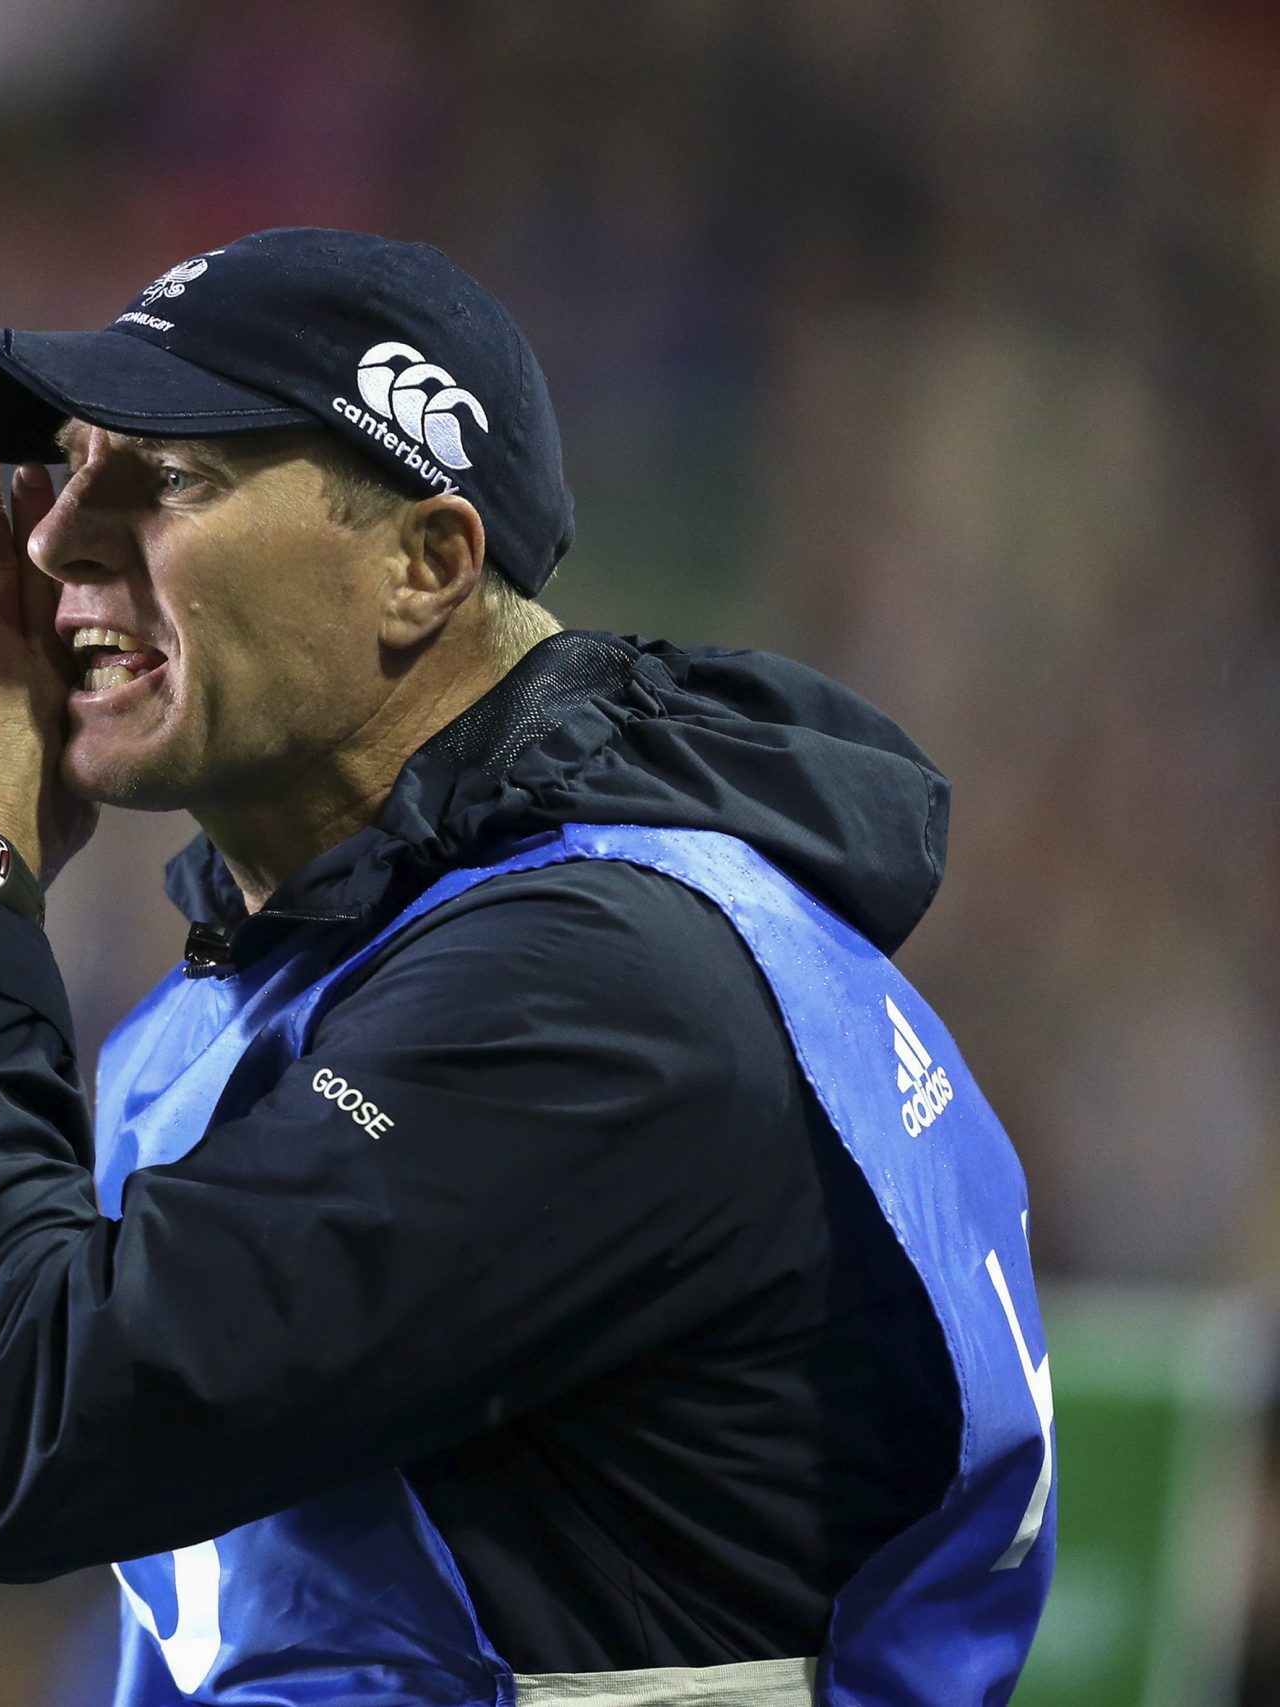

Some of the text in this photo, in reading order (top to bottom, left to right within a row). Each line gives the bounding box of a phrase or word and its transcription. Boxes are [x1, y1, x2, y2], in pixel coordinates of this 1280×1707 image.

[332, 397, 460, 495] canterbury
[312, 1068, 395, 1140] GOOSE
[901, 1066, 954, 1138] adidas
